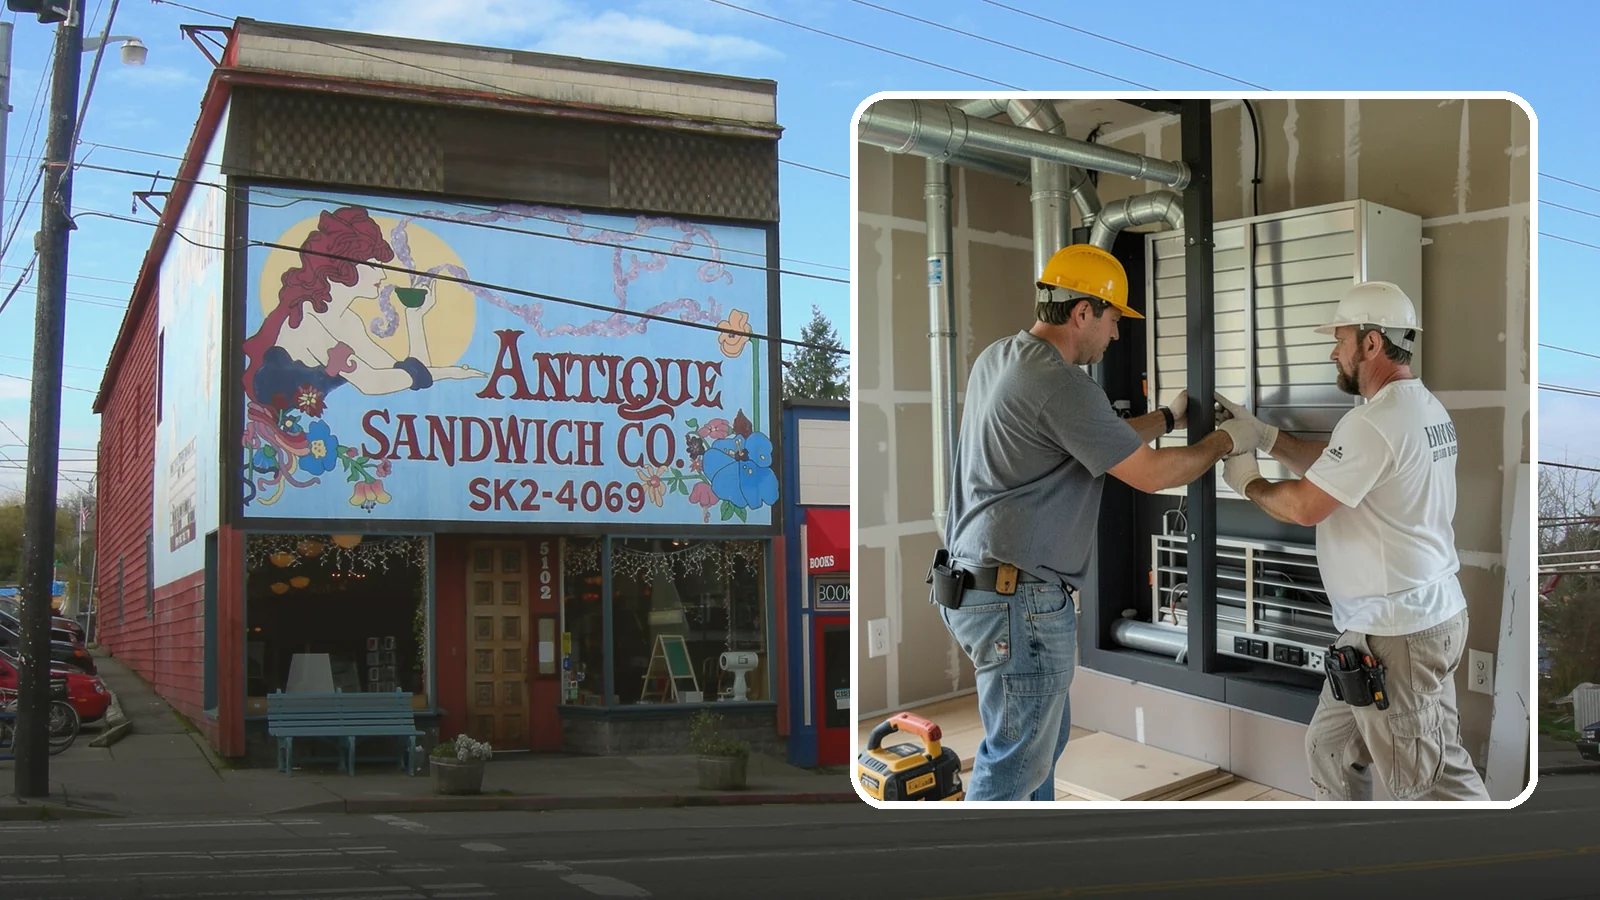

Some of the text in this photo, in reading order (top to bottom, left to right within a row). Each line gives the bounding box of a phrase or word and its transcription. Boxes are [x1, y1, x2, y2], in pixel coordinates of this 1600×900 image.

[476, 329, 723, 420] ANTIQUE
[361, 409, 686, 468] SANDWICH CO.
[468, 476, 647, 514] SK2-4069
[539, 541, 552, 600] 5102
[809, 555, 835, 569] BOOKS
